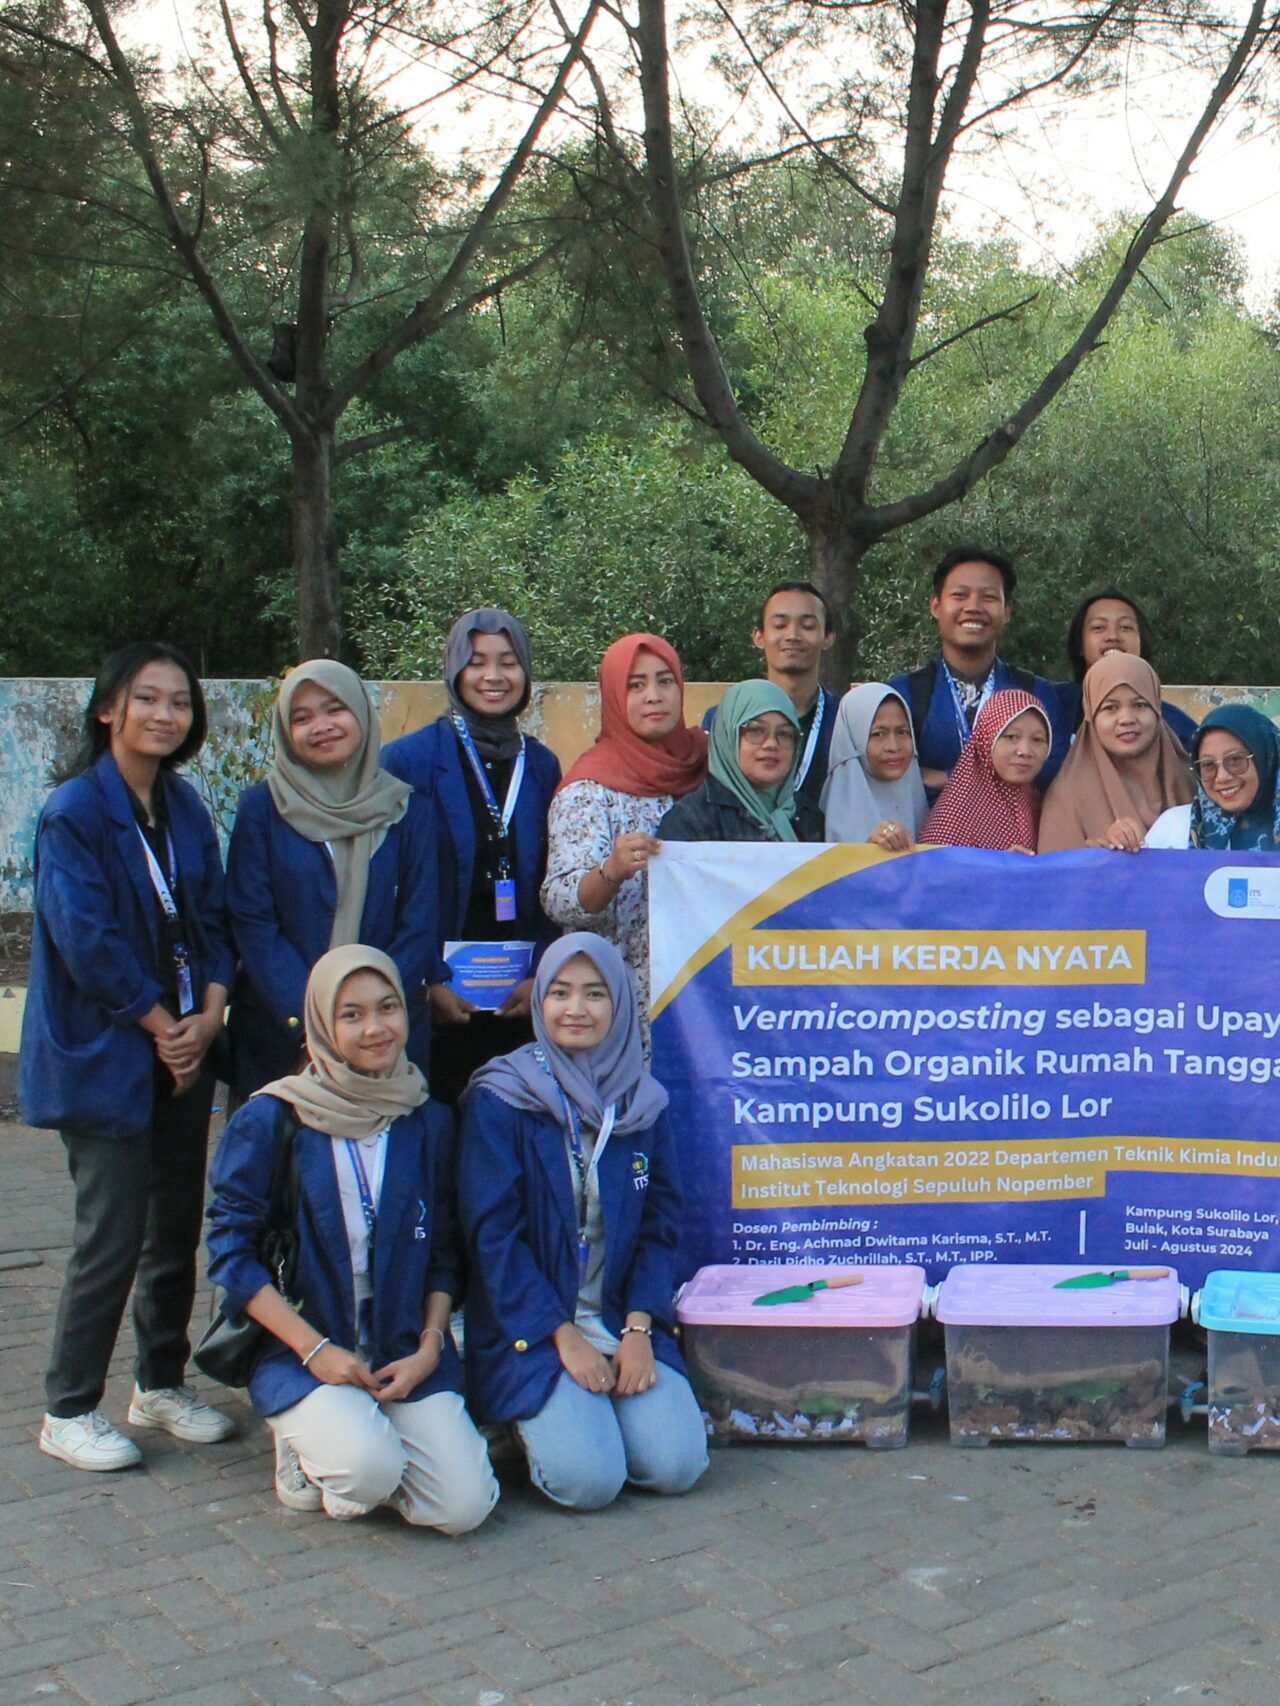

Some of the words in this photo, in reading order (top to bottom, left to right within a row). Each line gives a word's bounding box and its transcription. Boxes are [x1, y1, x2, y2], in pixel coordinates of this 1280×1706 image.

[747, 944, 880, 970] KULIAH
[892, 944, 1005, 970] KERJA
[1016, 944, 1132, 970] NYATA
[733, 1001, 1046, 1035] Vermicomposting
[1055, 1001, 1184, 1033] sebagai
[731, 1049, 873, 1082] Sampah
[884, 1047, 1024, 1081] Organik
[1036, 1046, 1152, 1073] Rumah
[734, 1097, 902, 1128] Kampung
[913, 1092, 1050, 1121] Sukolilo
[1062, 1094, 1112, 1118] Lor
[741, 1152, 843, 1170] Mahasiswa
[848, 1151, 938, 1171] Angkatan
[943, 1150, 989, 1166] 2022
[995, 1148, 1108, 1168] Departemen
[1113, 1145, 1173, 1162] Teknik
[1179, 1147, 1231, 1164] Kimia
[741, 1181, 810, 1197] Institut
[814, 1178, 907, 1198] Teknologi
[913, 1177, 991, 1196] Sepuluh
[996, 1174, 1093, 1194] Nopember
[733, 1223, 777, 1234] Dosen
[781, 1218, 870, 1233] Pembimbing
[1125, 1206, 1192, 1222] Kampung
[1196, 1209, 1250, 1222] Sukolilo
[1253, 1212, 1279, 1226] Lor,
[732, 1240, 741, 1251] 1.
[745, 1241, 766, 1251] Dr.
[770, 1240, 800, 1253] Eng.
[802, 1236, 860, 1250] Achmad
[865, 1235, 927, 1247] Dwitama
[931, 1233, 991, 1246] Karisma,
[994, 1233, 1021, 1245] S.T.,
[1025, 1231, 1051, 1243] M.T.
[1125, 1223, 1167, 1237] Bulak,
[1171, 1225, 1202, 1236] Kota
[1206, 1226, 1268, 1242] Surabaya
[829, 1253, 900, 1265] Zuchrillah,
[905, 1252, 931, 1264] S.T.,
[935, 1251, 966, 1263] M.T.,
[970, 1251, 997, 1262] IPP.
[1124, 1239, 1148, 1251] Juli
[1160, 1242, 1216, 1255] Agustus
[1219, 1244, 1252, 1257] 2024
